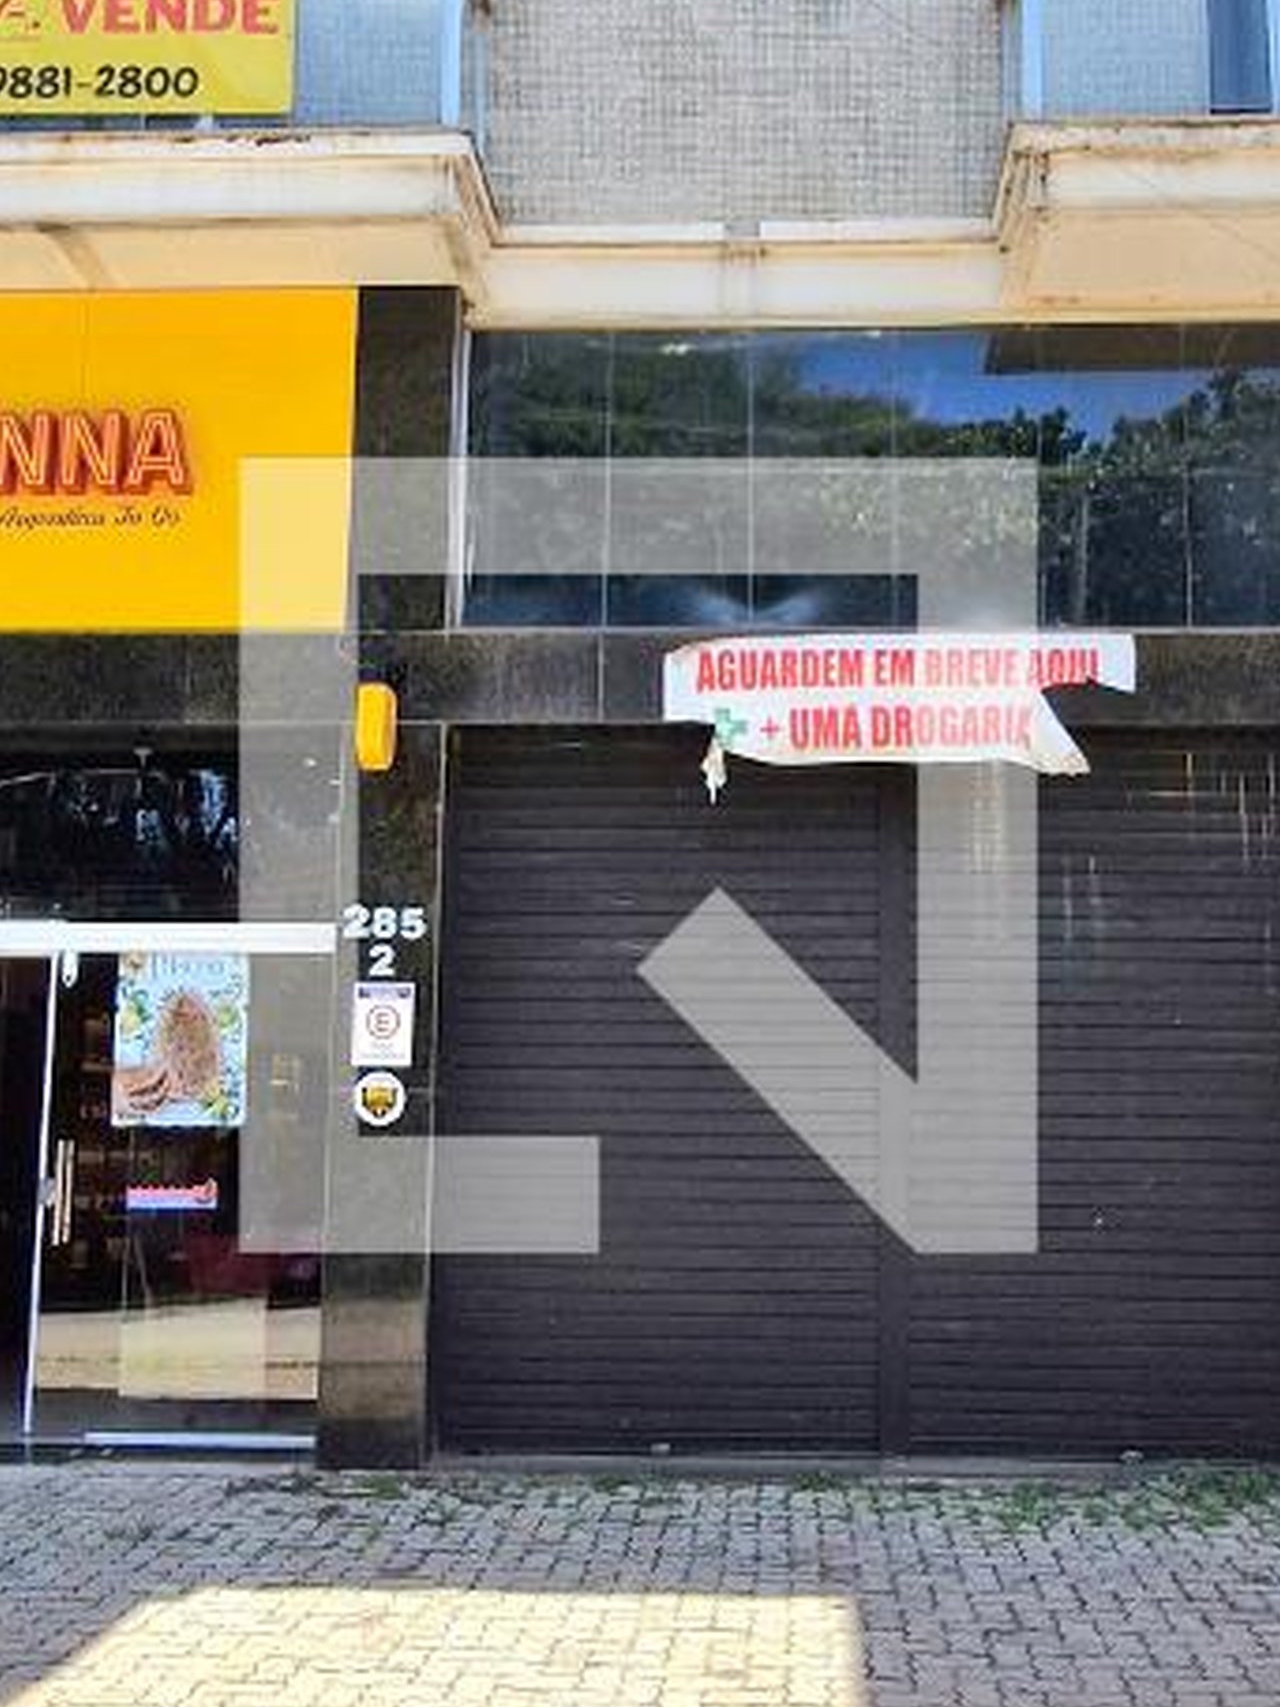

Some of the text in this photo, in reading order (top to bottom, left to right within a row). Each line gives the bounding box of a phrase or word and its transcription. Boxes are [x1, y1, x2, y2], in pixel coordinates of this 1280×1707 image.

[697, 648, 864, 692] AGUARDEM
[873, 649, 915, 688] EM
[924, 648, 1018, 689] BREVE
[789, 706, 862, 750] UMA
[871, 704, 1032, 748] DROGARIA
[342, 904, 427, 939] 285
[368, 944, 395, 976] 2
